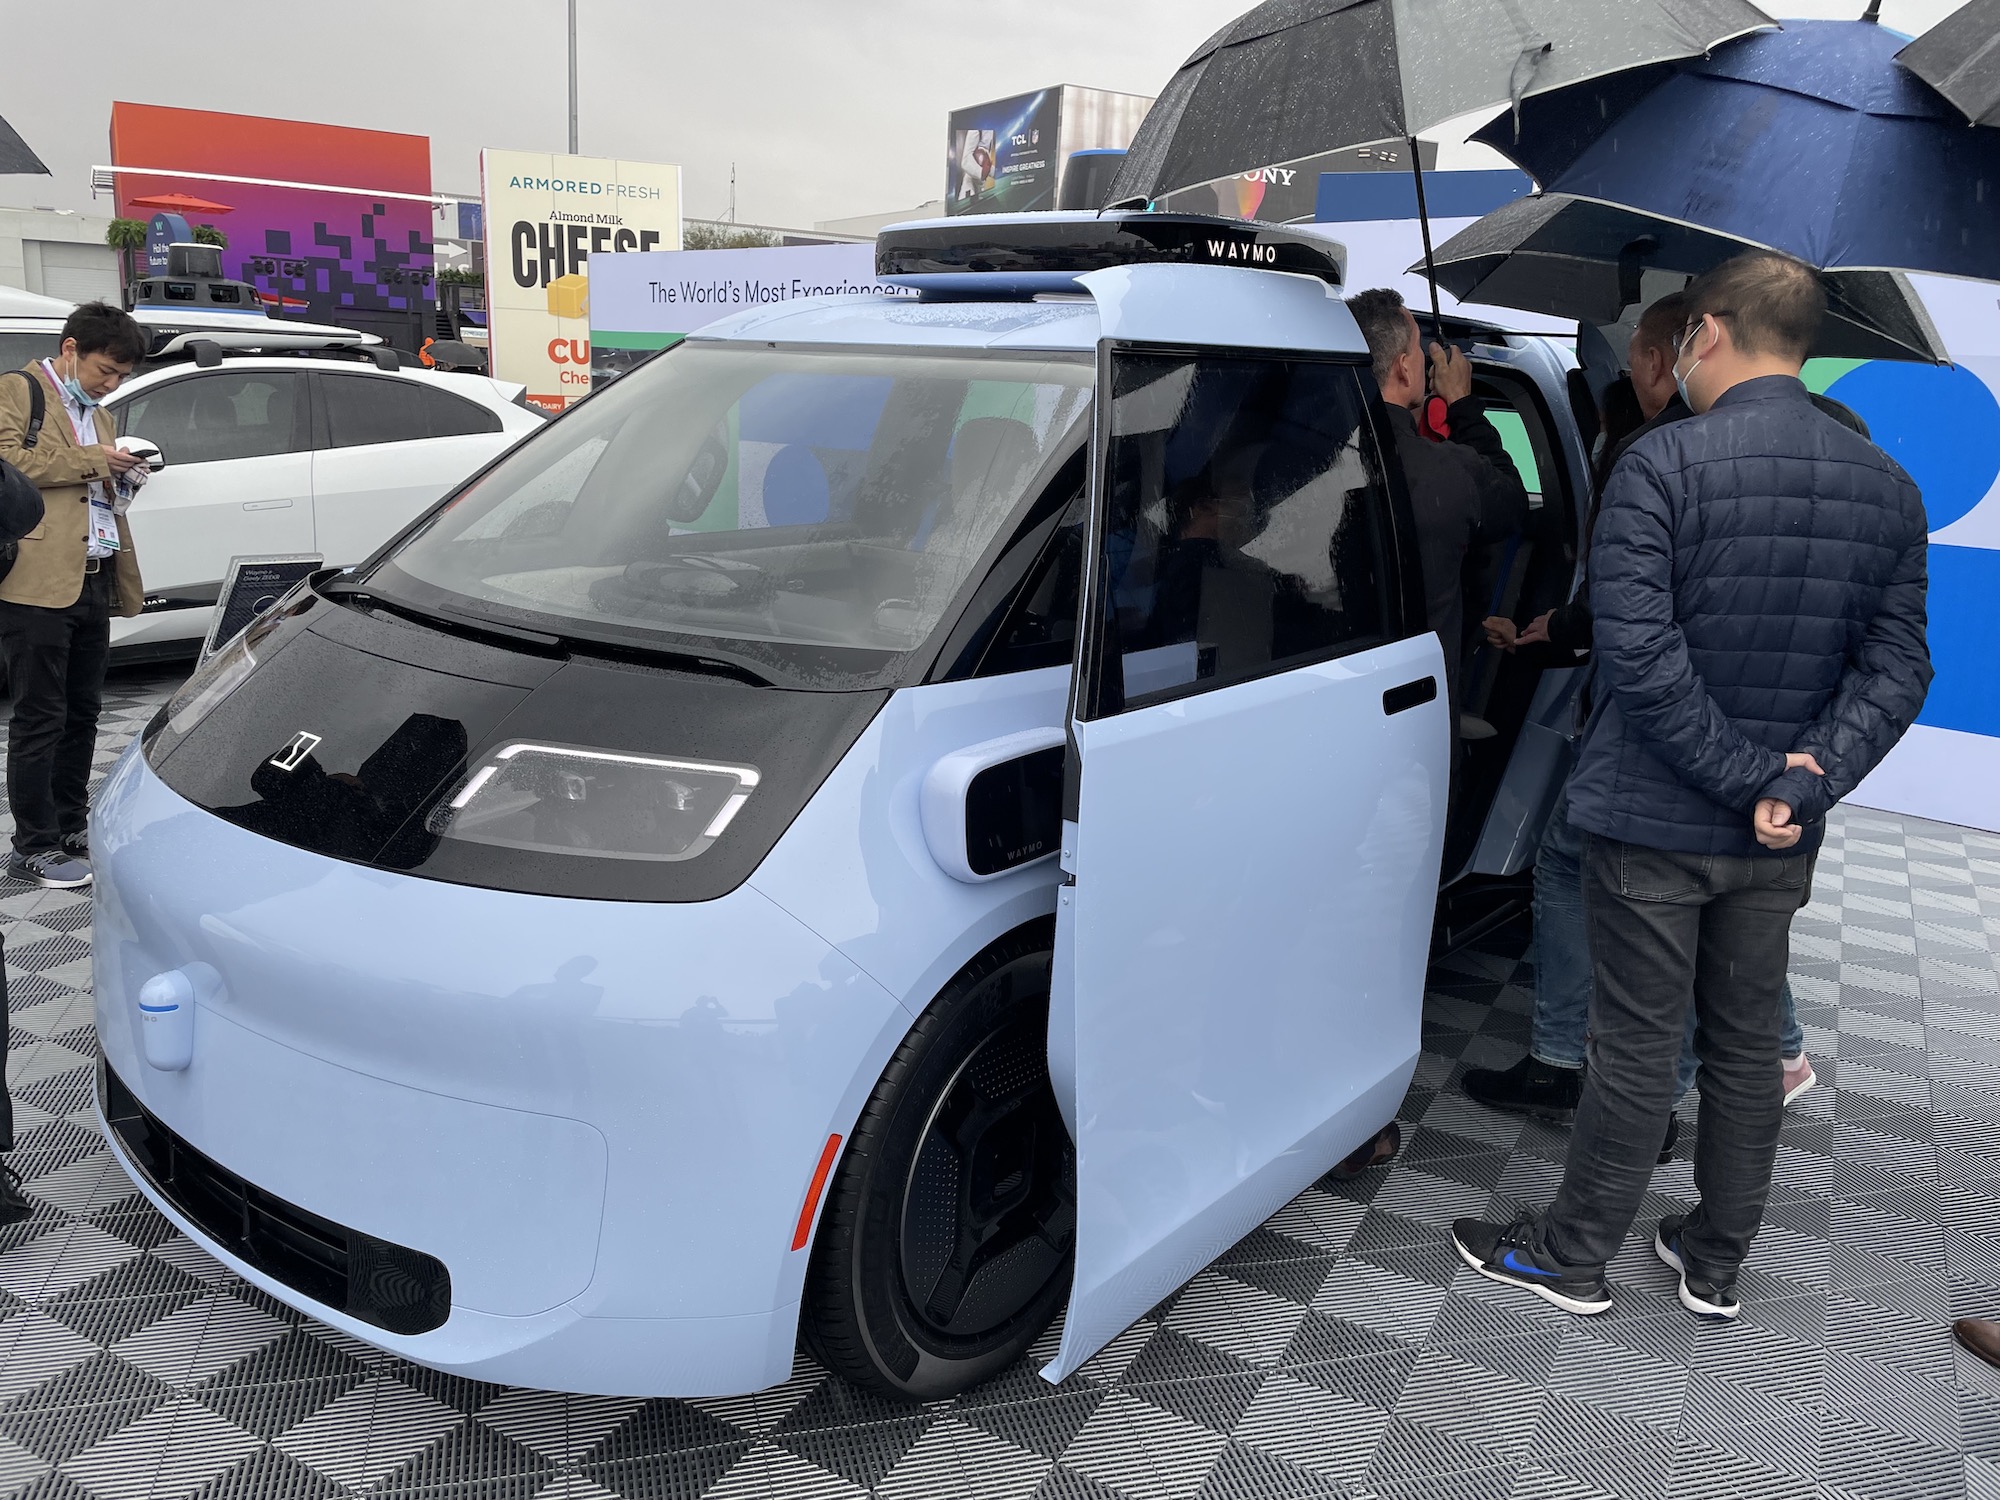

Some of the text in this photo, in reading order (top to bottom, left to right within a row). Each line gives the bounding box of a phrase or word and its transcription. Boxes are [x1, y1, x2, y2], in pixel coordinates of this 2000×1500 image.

[1011, 134, 1027, 146] TCL
[1232, 168, 1296, 186] ONY
[509, 176, 660, 200] ARMORED FRESH
[549, 211, 623, 226] Almond Milk
[1207, 239, 1276, 264] WAYMO
[649, 281, 676, 303] The
[680, 280, 741, 303] World’s
[745, 280, 787, 303] Most
[560, 371, 589, 385] Che
[542, 402, 562, 410] DAIRY
[1007, 840, 1043, 861] WAYMO
